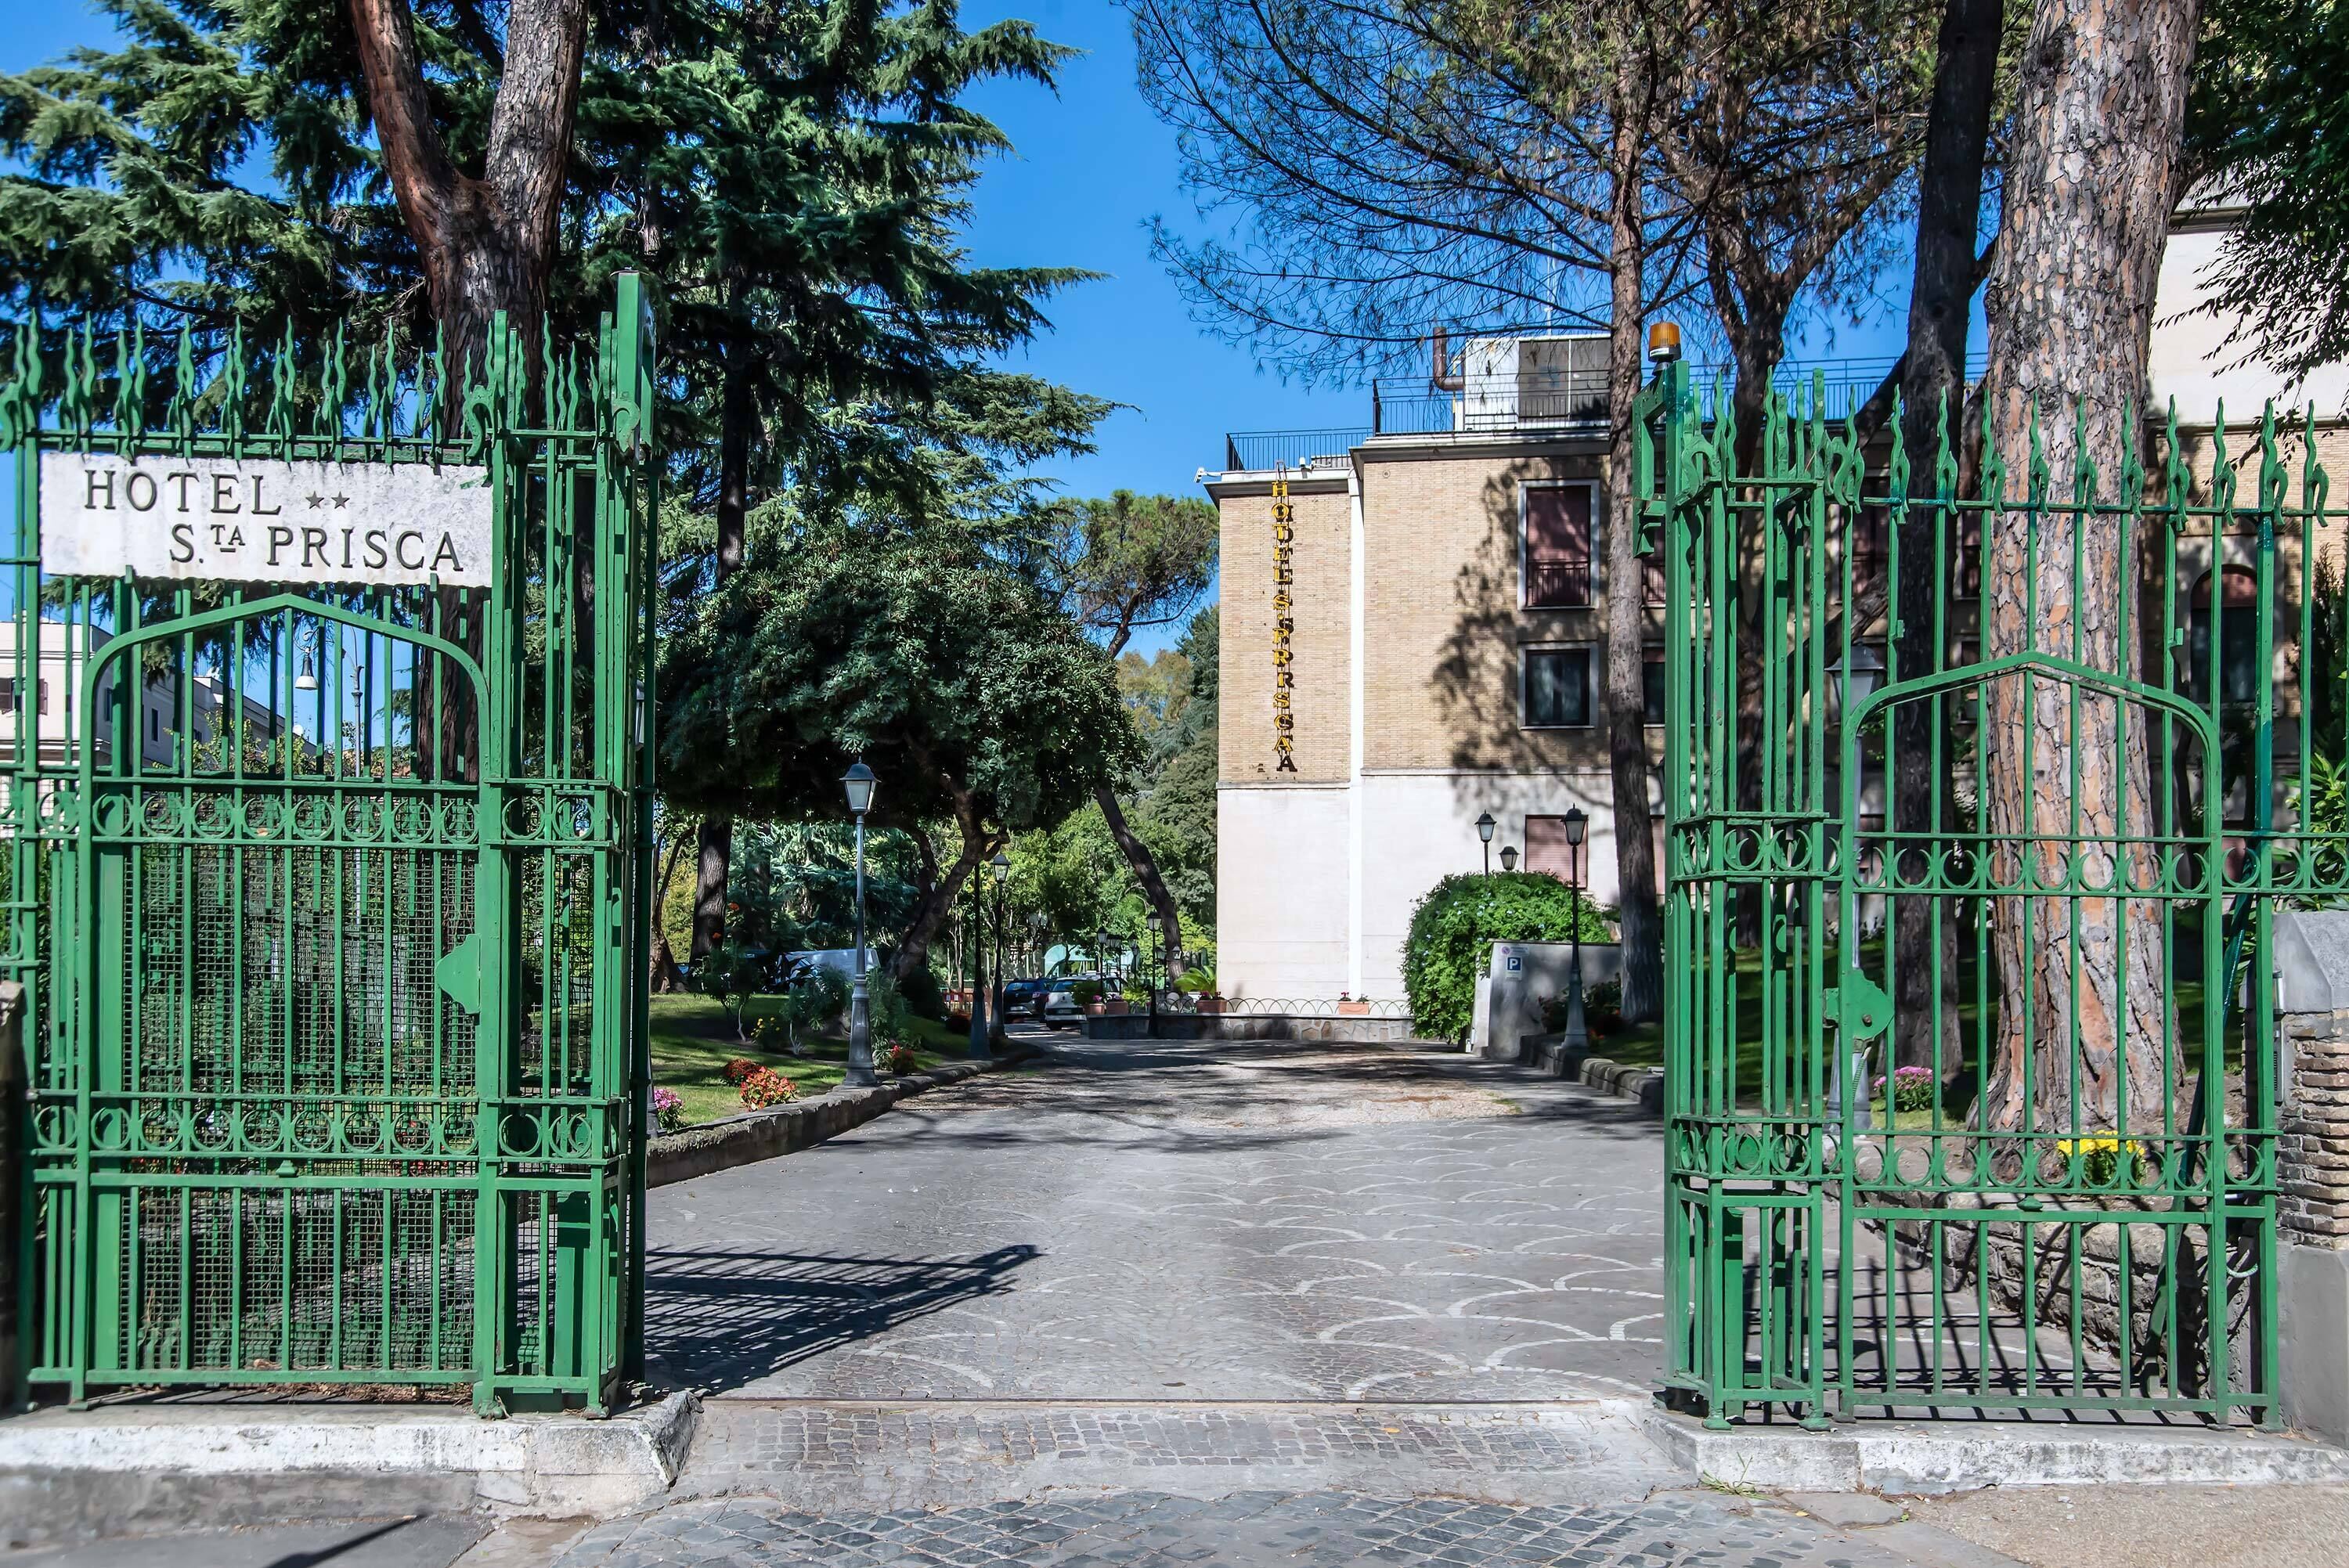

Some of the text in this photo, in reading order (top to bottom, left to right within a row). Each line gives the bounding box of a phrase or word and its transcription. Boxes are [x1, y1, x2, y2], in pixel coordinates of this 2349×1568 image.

[85, 470, 282, 516] HOTEL
[266, 525, 464, 571] PRISCA
[1272, 481, 1290, 582] HOTEL
[1272, 627, 1293, 752] PRISCA
[1509, 957, 1518, 970] P
